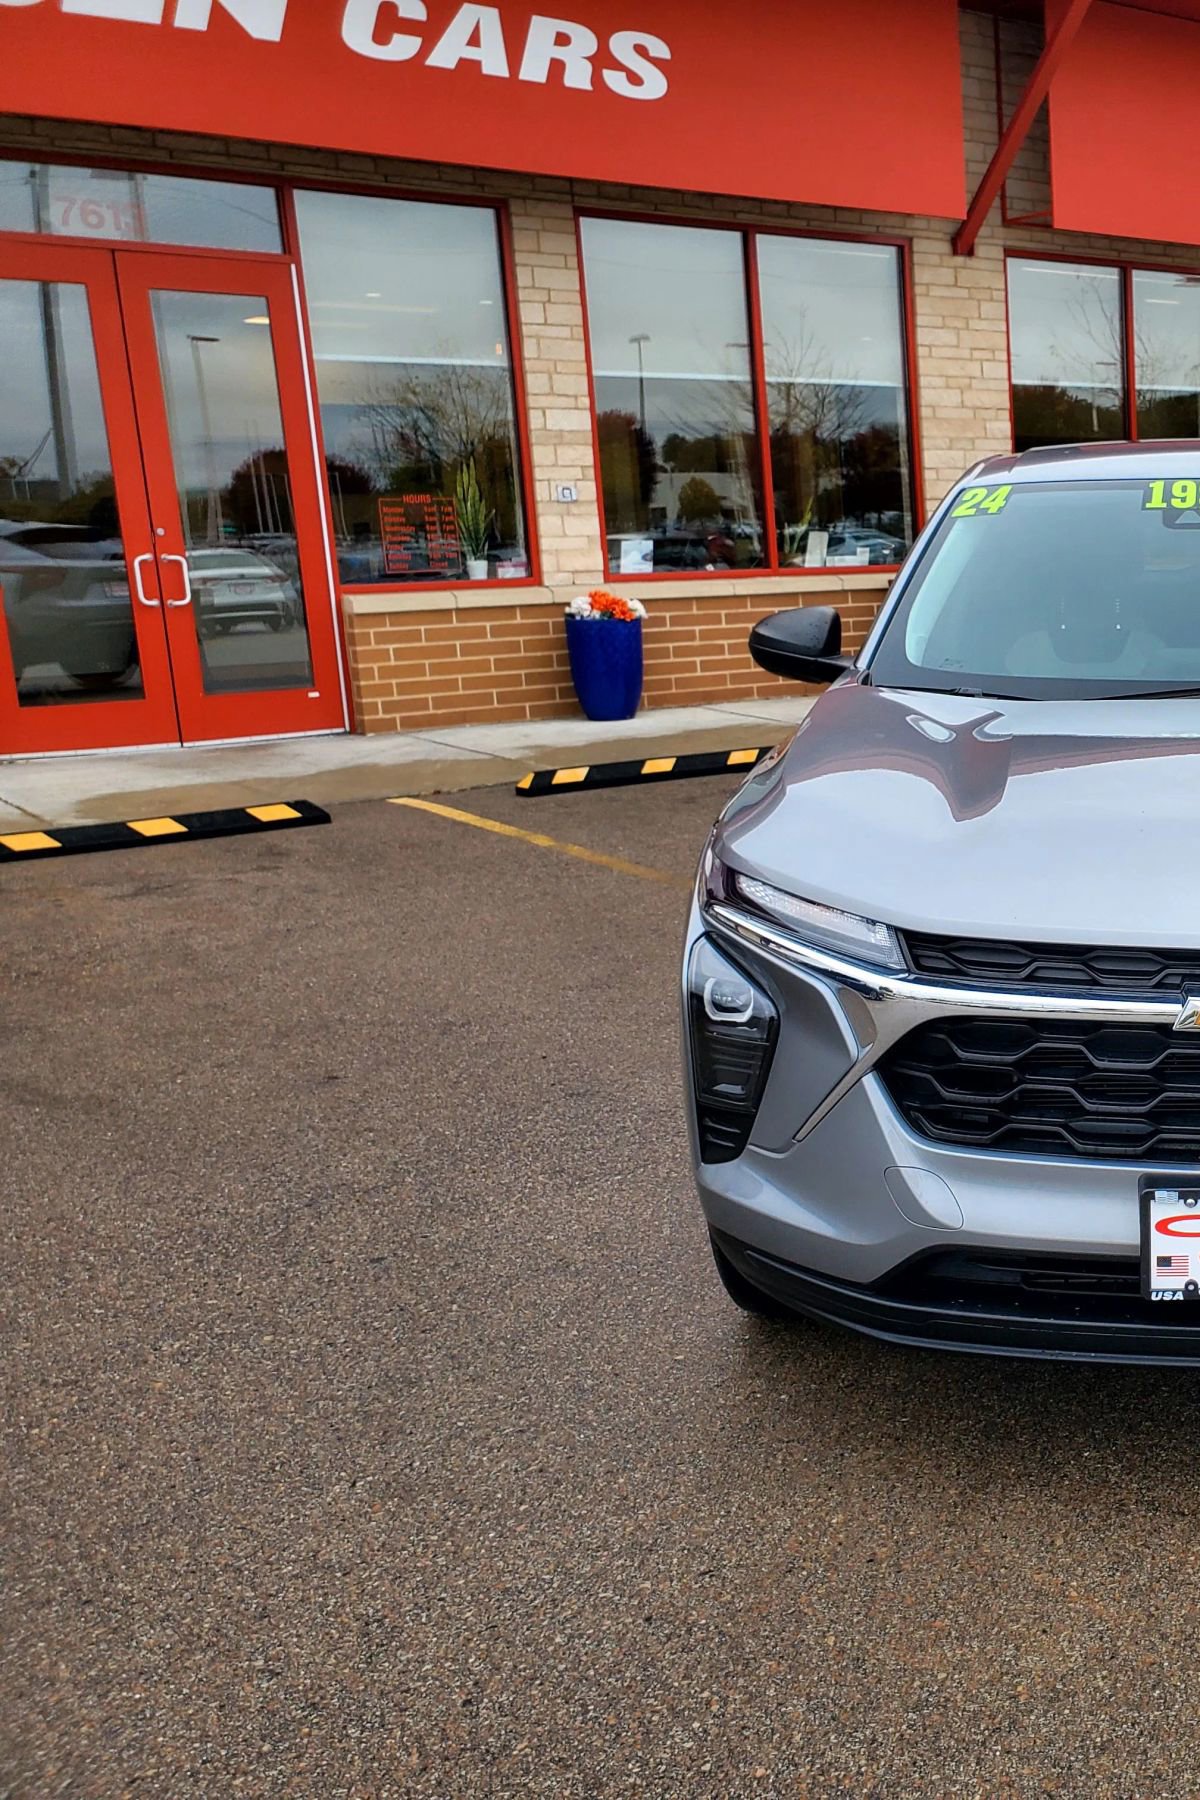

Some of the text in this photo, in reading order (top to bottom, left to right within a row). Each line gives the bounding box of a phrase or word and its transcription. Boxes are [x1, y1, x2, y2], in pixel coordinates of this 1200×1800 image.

[340, 0, 672, 100] CARS
[952, 486, 1010, 517] 24
[1151, 1290, 1184, 1301] USA
